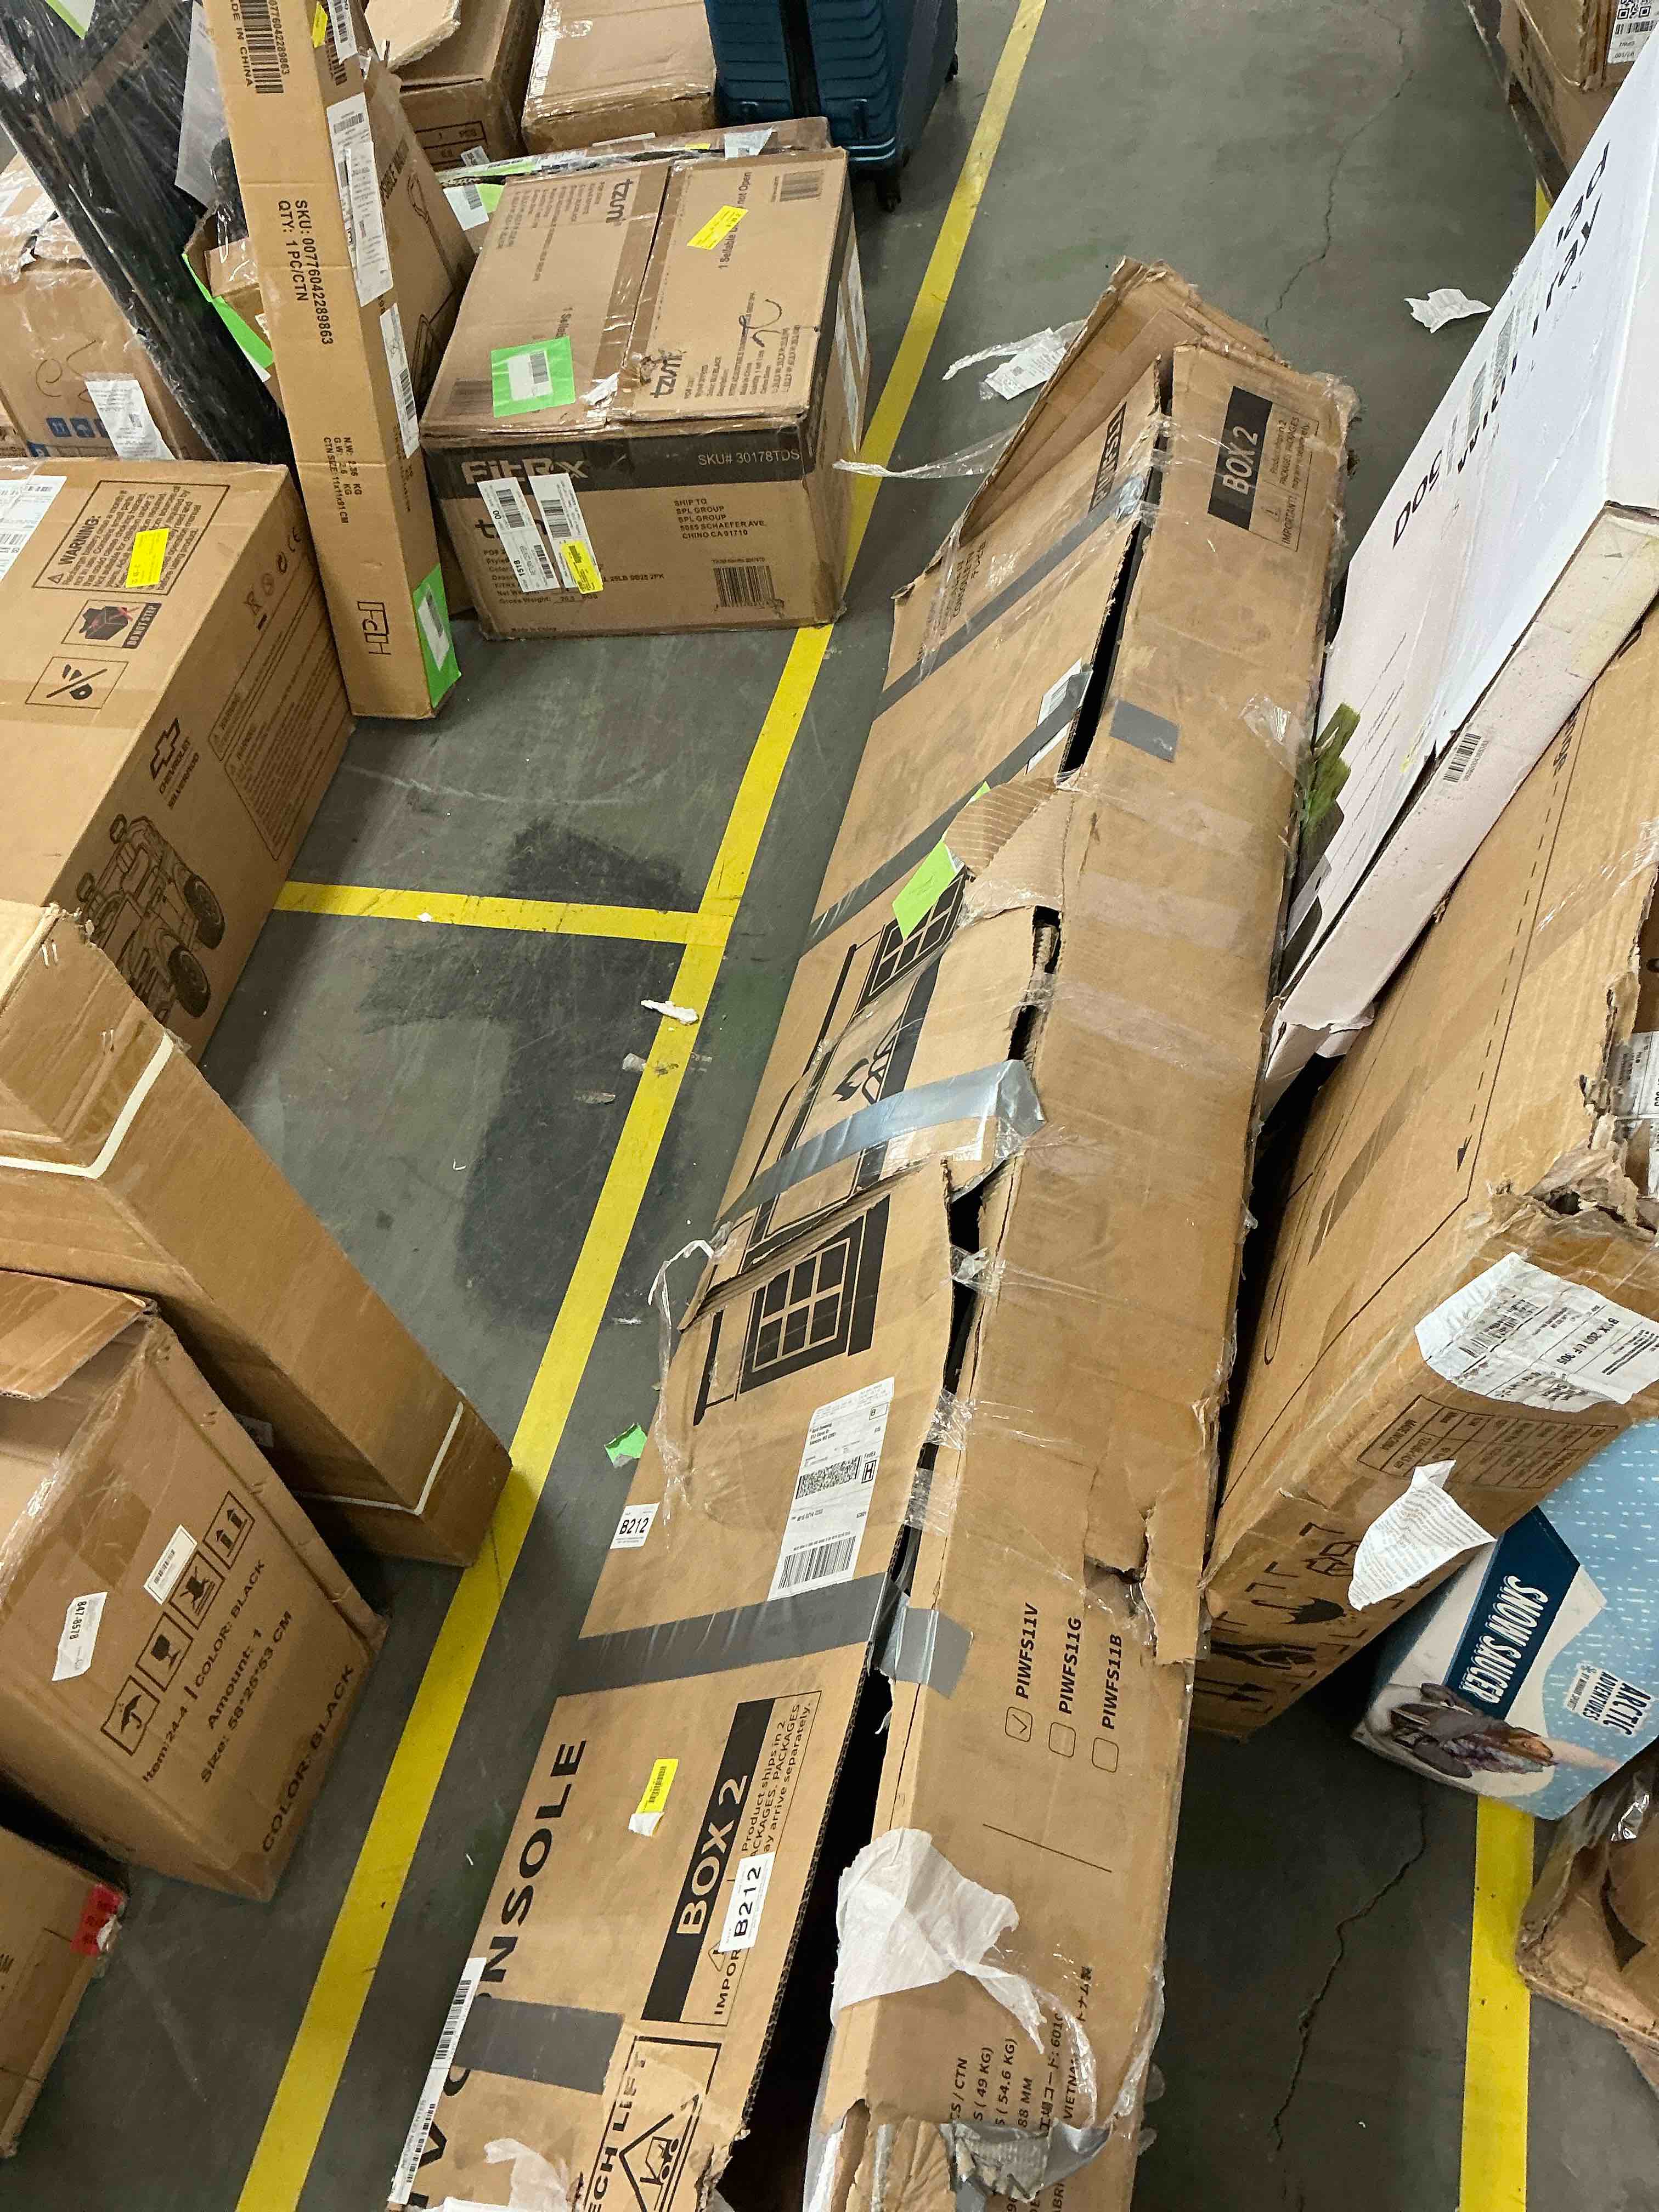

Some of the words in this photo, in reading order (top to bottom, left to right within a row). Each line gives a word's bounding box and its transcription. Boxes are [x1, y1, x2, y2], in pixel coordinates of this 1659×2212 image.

[236, 28, 244, 40] IN
[240, 47, 253, 87] CHINA
[278, 200, 295, 233] QTY:
[287, 251, 309, 301] PC/CTN
[698, 454, 733, 466] SKU#
[736, 449, 800, 464] 30178TDS
[1233, 426, 1259, 446] 2
[343, 483, 352, 495] KG
[353, 483, 362, 495] KG
[1222, 441, 1256, 495] BOX
[57, 515, 102, 565] WARNING:
[1282, 495, 1299, 545] IMPORTANT!
[1595, 1317, 1621, 1334] BX
[866, 1463, 874, 1480] H
[619, 1517, 649, 1534] B212
[69, 1600, 87, 1640] 847-8578
[195, 1620, 233, 1689] COLOR:
[232, 1559, 265, 1618] BLACK
[1485, 1575, 1549, 1649] SNOW
[1016, 1602, 1039, 1699] PIWFS11V
[1059, 1617, 1084, 1715] PIWFS11G
[1458, 1635, 1523, 1704] SAUCER
[201, 1735, 232, 1783] Size:
[273, 1609, 293, 1644] CM
[208, 1647, 255, 1730] Amount:
[1102, 1633, 1122, 1730] PIWFS11B
[1583, 1672, 1618, 1720] ADVENTURES
[1603, 1683, 1651, 1735] ARCTIC
[262, 1757, 311, 1854] COLOR:
[309, 1664, 355, 1752] BLACK
[772, 1703, 800, 1780] PACKAGES
[742, 1792, 764, 1852] Product
[761, 1750, 776, 1787] ships
[772, 1733, 781, 1746] in
[777, 1720, 786, 1729] 2
[764, 1835, 774, 1852] ay
[770, 1786, 787, 1830] arrive
[784, 1702, 811, 1782] separately.
[676, 1820, 734, 1936] BOX
[719, 1775, 748, 1806] 2
[734, 1866, 761, 1937] B212
[955, 2057, 967, 2089] CTN
[979, 2047, 994, 2074] KG)
[1003, 2038, 1018, 2065] KG)
[977, 2078, 988, 2097] 49
[998, 2070, 1011, 2104] 54.6
[1020, 2078, 1032, 2103] MM
[1063, 2057, 1079, 2119] VIETNA
[973, 2111, 983, 2121] S
[1018, 2109, 1029, 2128] 88
